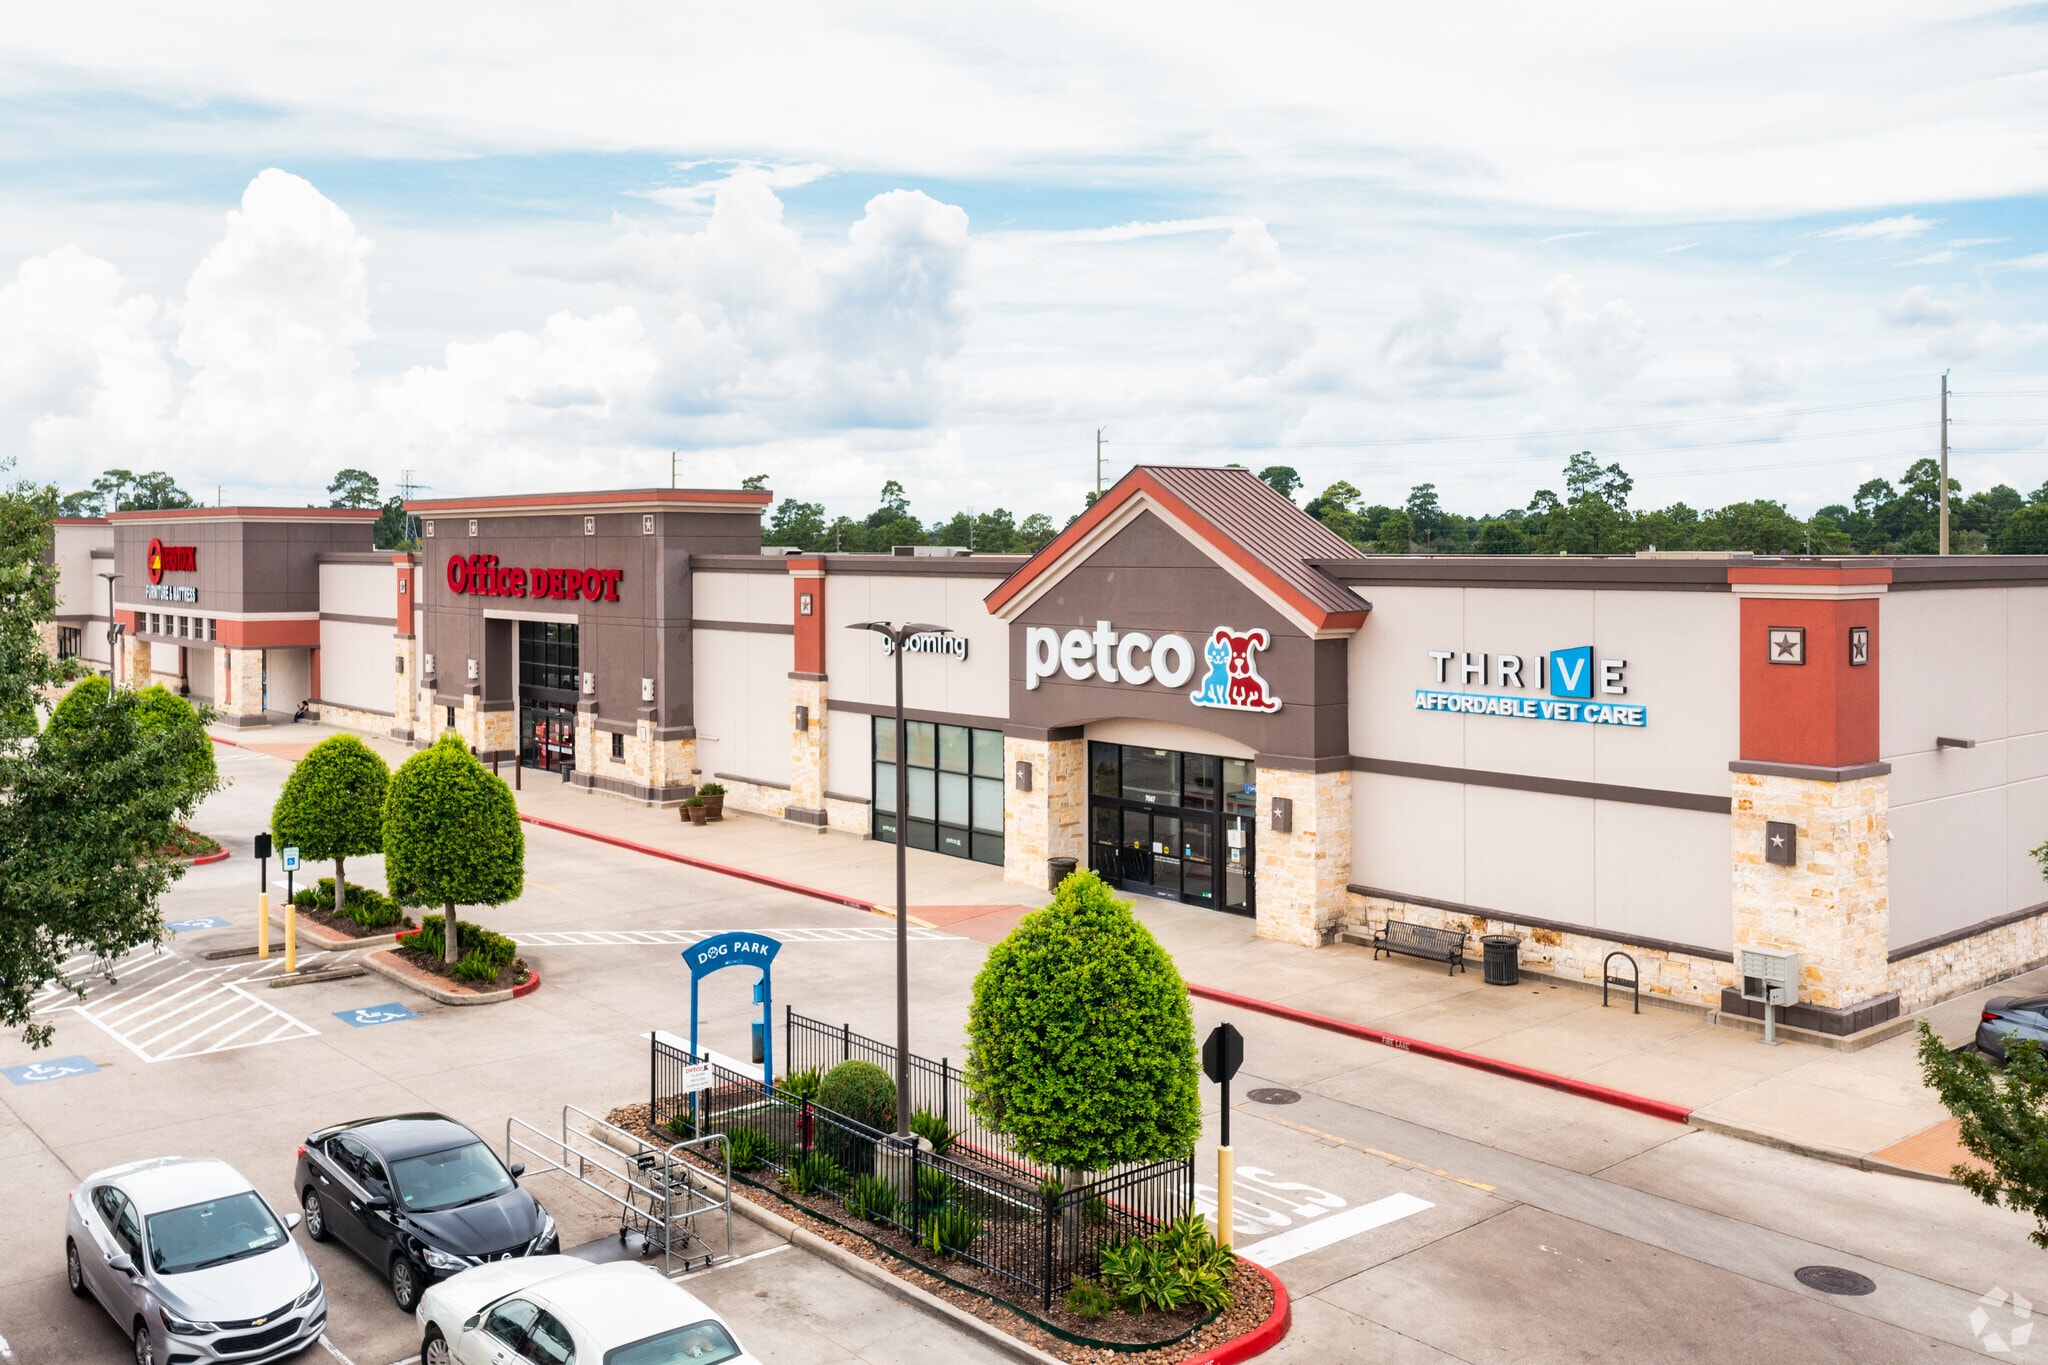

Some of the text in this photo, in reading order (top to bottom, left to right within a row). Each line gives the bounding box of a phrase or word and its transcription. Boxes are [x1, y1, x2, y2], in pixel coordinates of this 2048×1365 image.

[446, 554, 622, 601] Office DEPOT
[1026, 620, 1196, 690] petco
[1428, 650, 1627, 694] THRIVE
[1414, 692, 1645, 726] AFFORDABLE VET CARE
[697, 941, 769, 965] DOG PARK
[1381, 1036, 1410, 1051] FIRE LANE
[685, 1065, 703, 1074] petco
